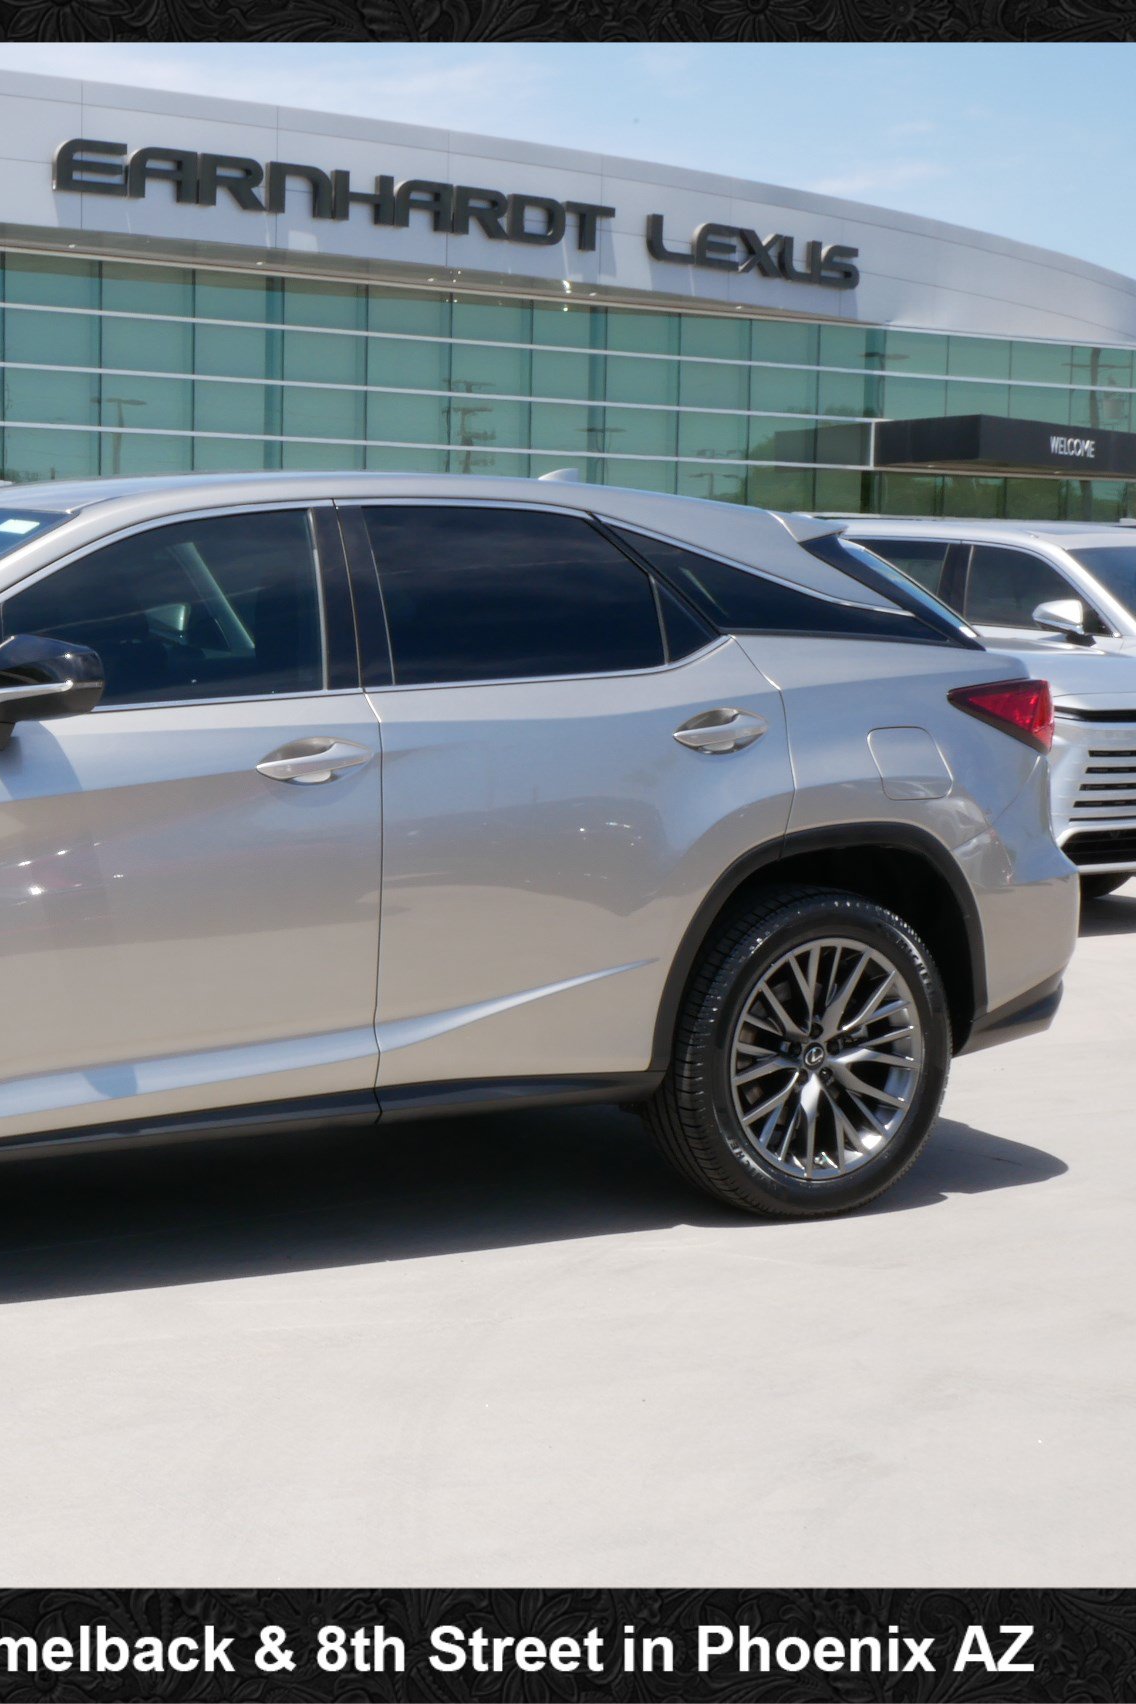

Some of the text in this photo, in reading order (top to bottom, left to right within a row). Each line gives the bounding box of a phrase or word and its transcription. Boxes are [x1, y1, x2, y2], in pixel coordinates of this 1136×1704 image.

[53, 138, 860, 289] EARNHARDT LEXUS
[1050, 435, 1096, 458] WELCOME
